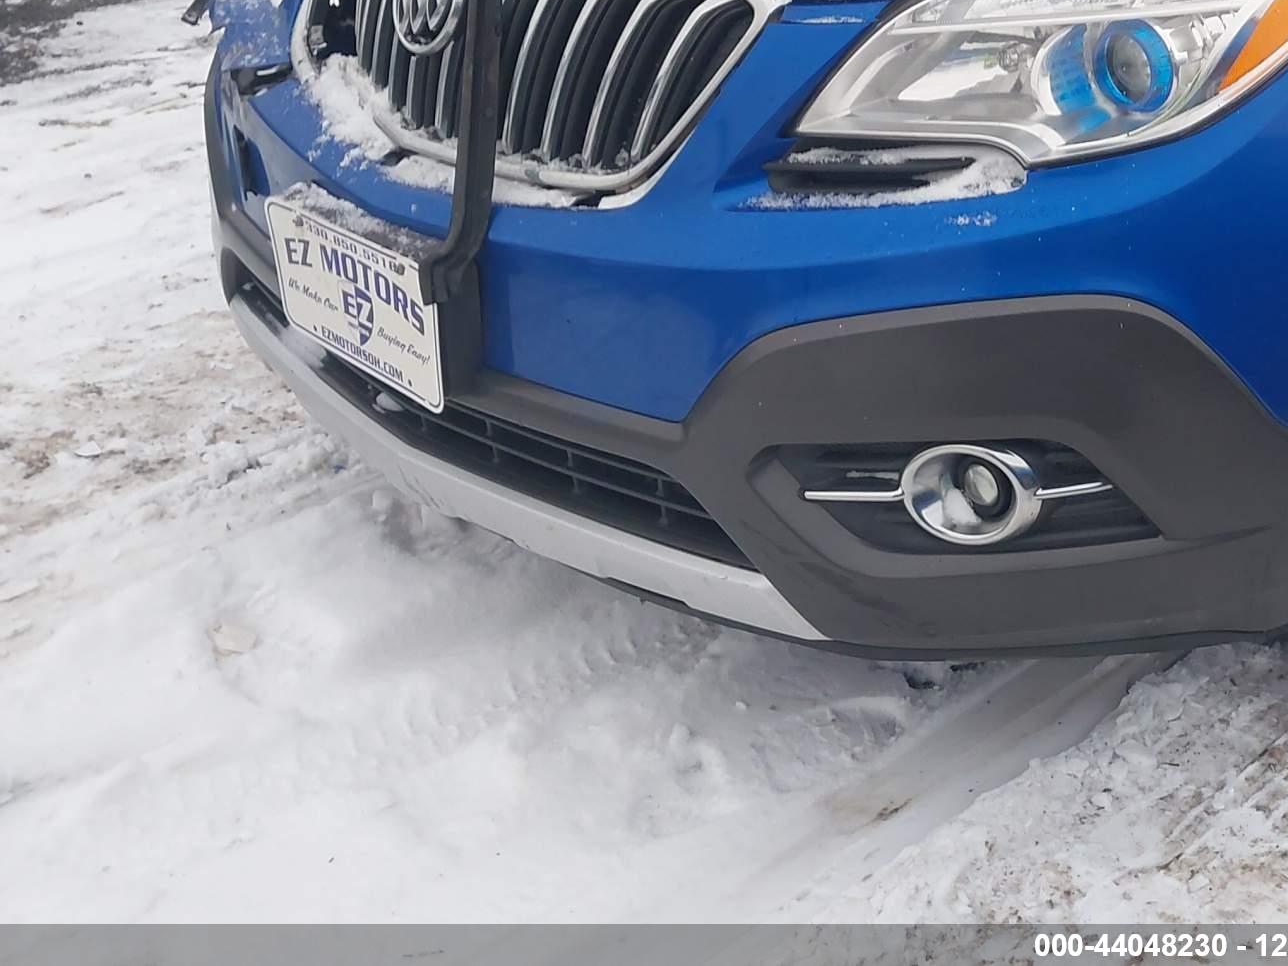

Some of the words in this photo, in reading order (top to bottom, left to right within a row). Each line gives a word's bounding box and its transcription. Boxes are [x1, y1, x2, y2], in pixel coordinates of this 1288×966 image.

[284, 238, 313, 268] EZ
[320, 243, 425, 336] MOTORS
[342, 289, 373, 327] EZ
[321, 325, 404, 383] EZMOTORSOH.COM
[377, 326, 406, 354] Buying
